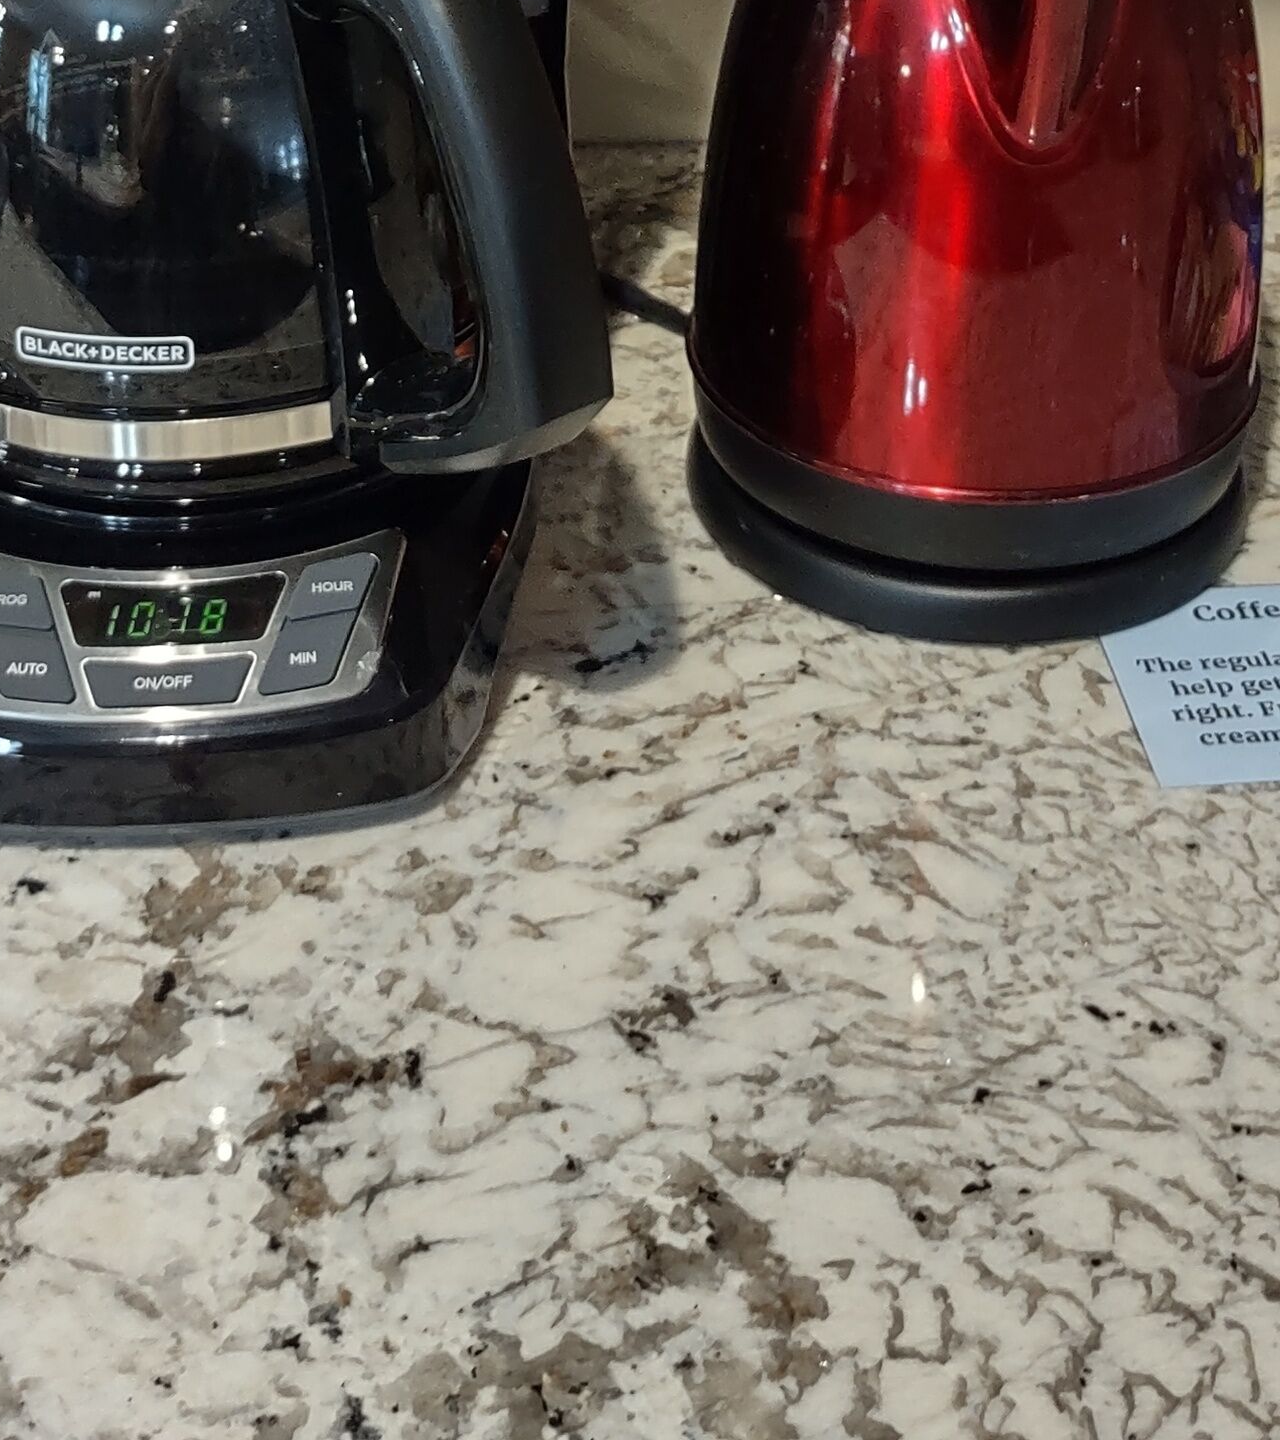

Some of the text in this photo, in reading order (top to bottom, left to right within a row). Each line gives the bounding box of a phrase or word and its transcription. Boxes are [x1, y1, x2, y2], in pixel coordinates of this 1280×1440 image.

[23, 335, 186, 362] BLACK+DECKER
[311, 579, 354, 594] HOUR
[289, 650, 317, 665] MIN
[1136, 656, 1193, 674] The
[6, 661, 48, 676] AUTO
[133, 675, 193, 691] ON/OFF
[1169, 677, 1234, 698] help
[1172, 702, 1254, 725] right.
